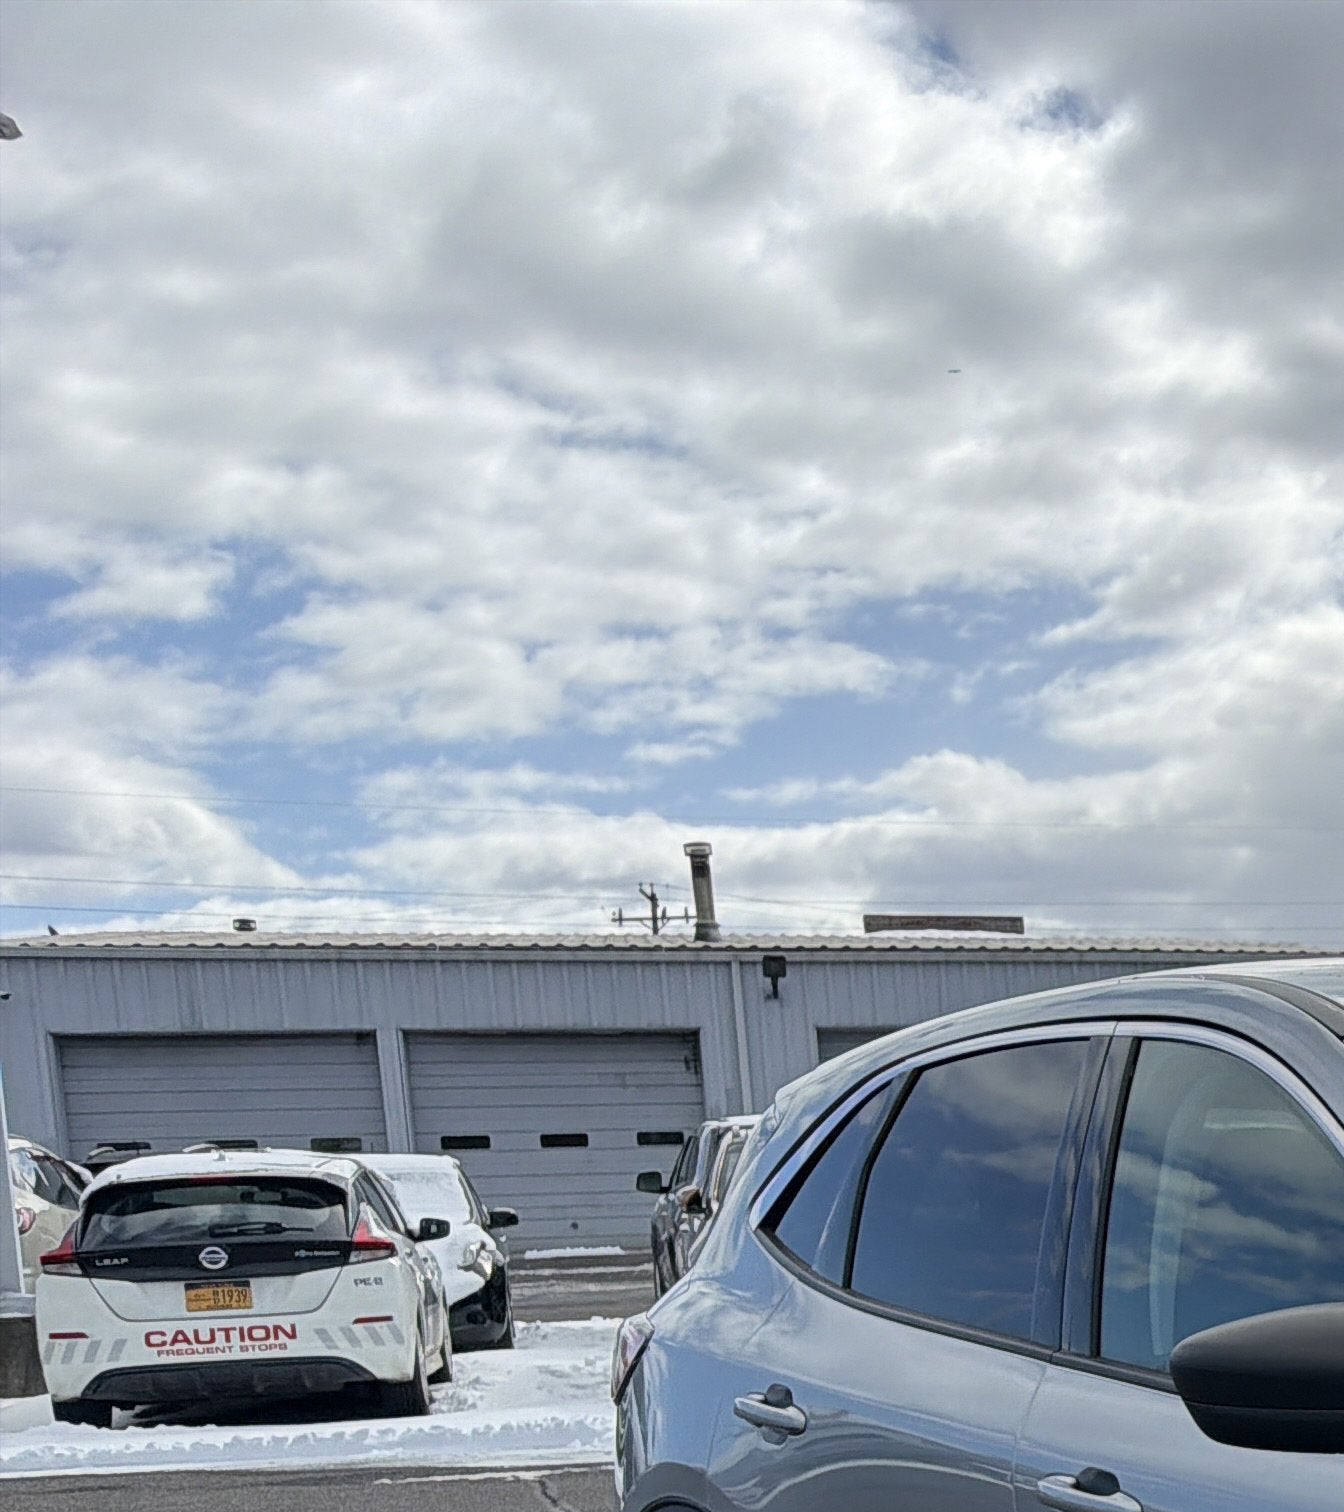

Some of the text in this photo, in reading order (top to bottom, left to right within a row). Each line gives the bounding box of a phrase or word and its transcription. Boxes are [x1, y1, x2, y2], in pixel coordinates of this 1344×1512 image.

[143, 1322, 298, 1348] CAUTION
[156, 1342, 289, 1358] FREQUENT STOPS
